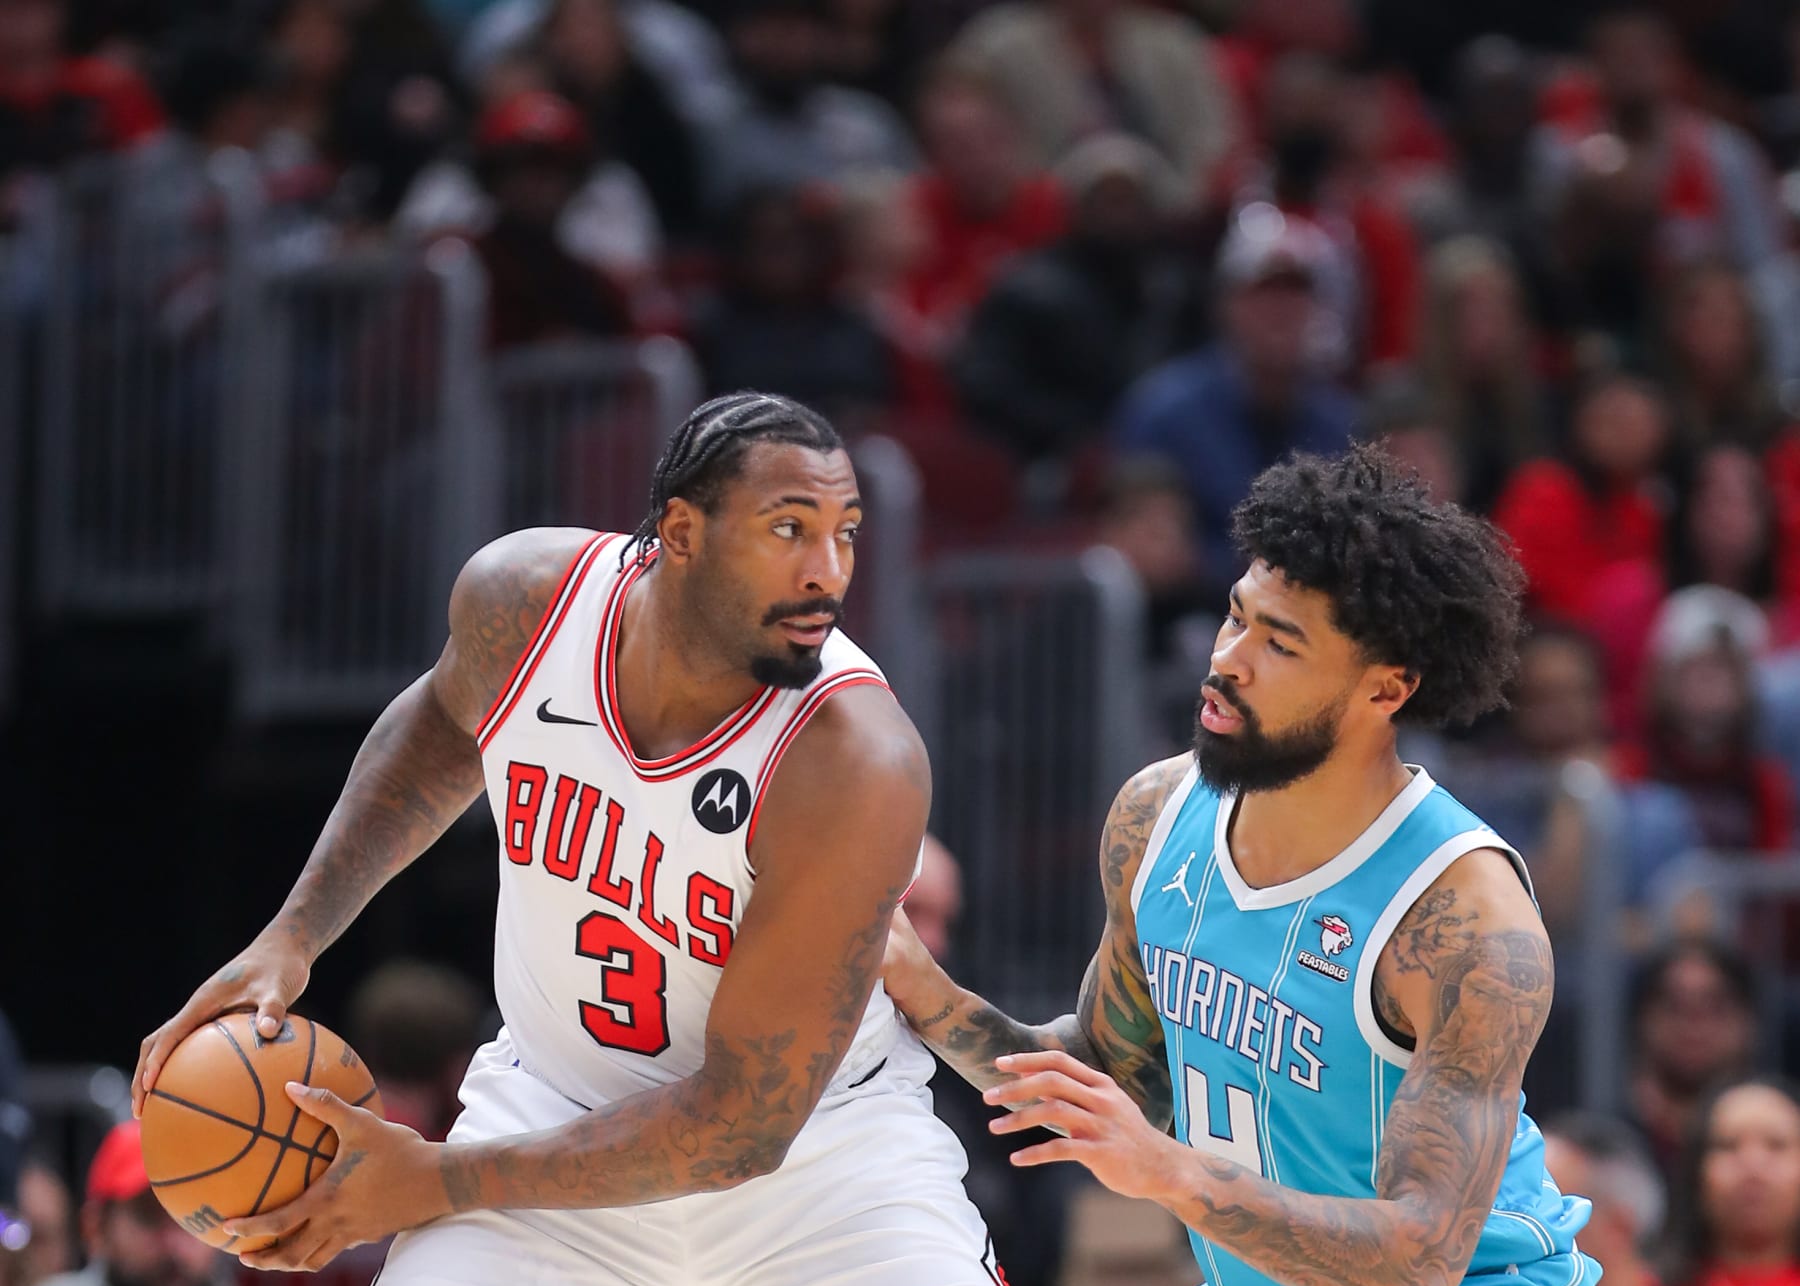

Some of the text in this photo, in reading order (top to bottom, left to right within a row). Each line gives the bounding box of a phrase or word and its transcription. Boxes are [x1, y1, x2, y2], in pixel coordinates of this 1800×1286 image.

[505, 760, 735, 968] BULLS
[575, 910, 671, 1057] 3
[1143, 942, 1329, 1092] HORNETS
[1298, 951, 1349, 981] FEASTABLES
